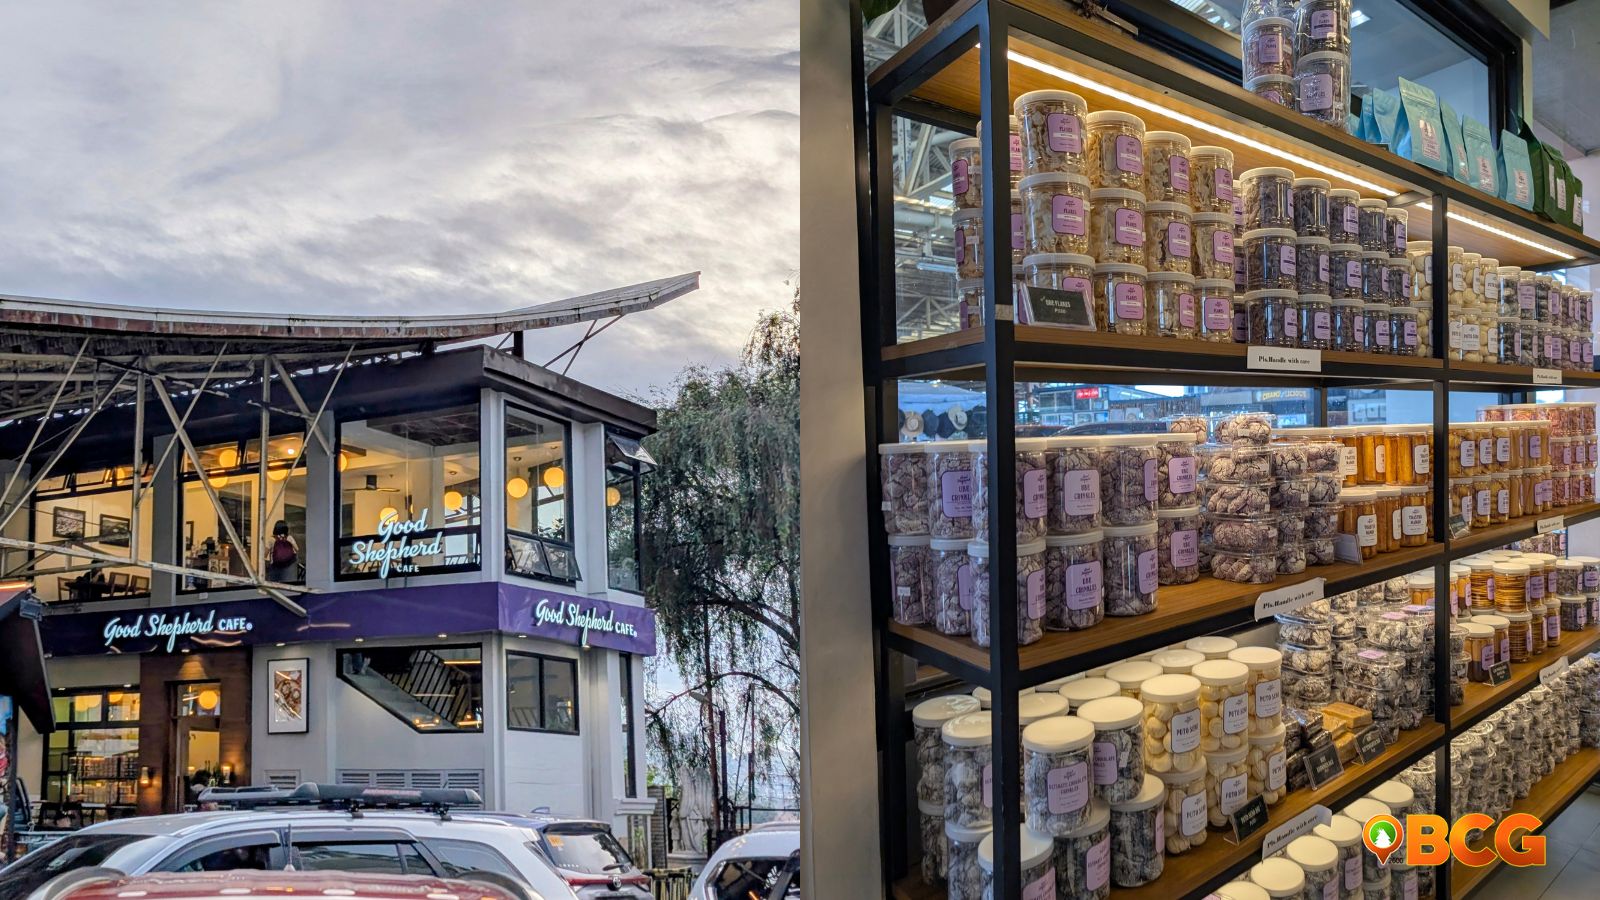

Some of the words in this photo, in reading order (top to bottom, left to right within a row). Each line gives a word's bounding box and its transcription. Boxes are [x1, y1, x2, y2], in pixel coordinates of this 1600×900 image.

[951, 493, 972, 502] CRINKL
[378, 507, 429, 545] Good
[348, 531, 443, 579] Shepherd
[396, 564, 420, 573] CAFE
[103, 614, 144, 647] Good
[144, 609, 216, 653] Shepherd
[535, 598, 565, 627] Good
[565, 603, 614, 647] Shepherd
[1176, 727, 1190, 736] PUTO
